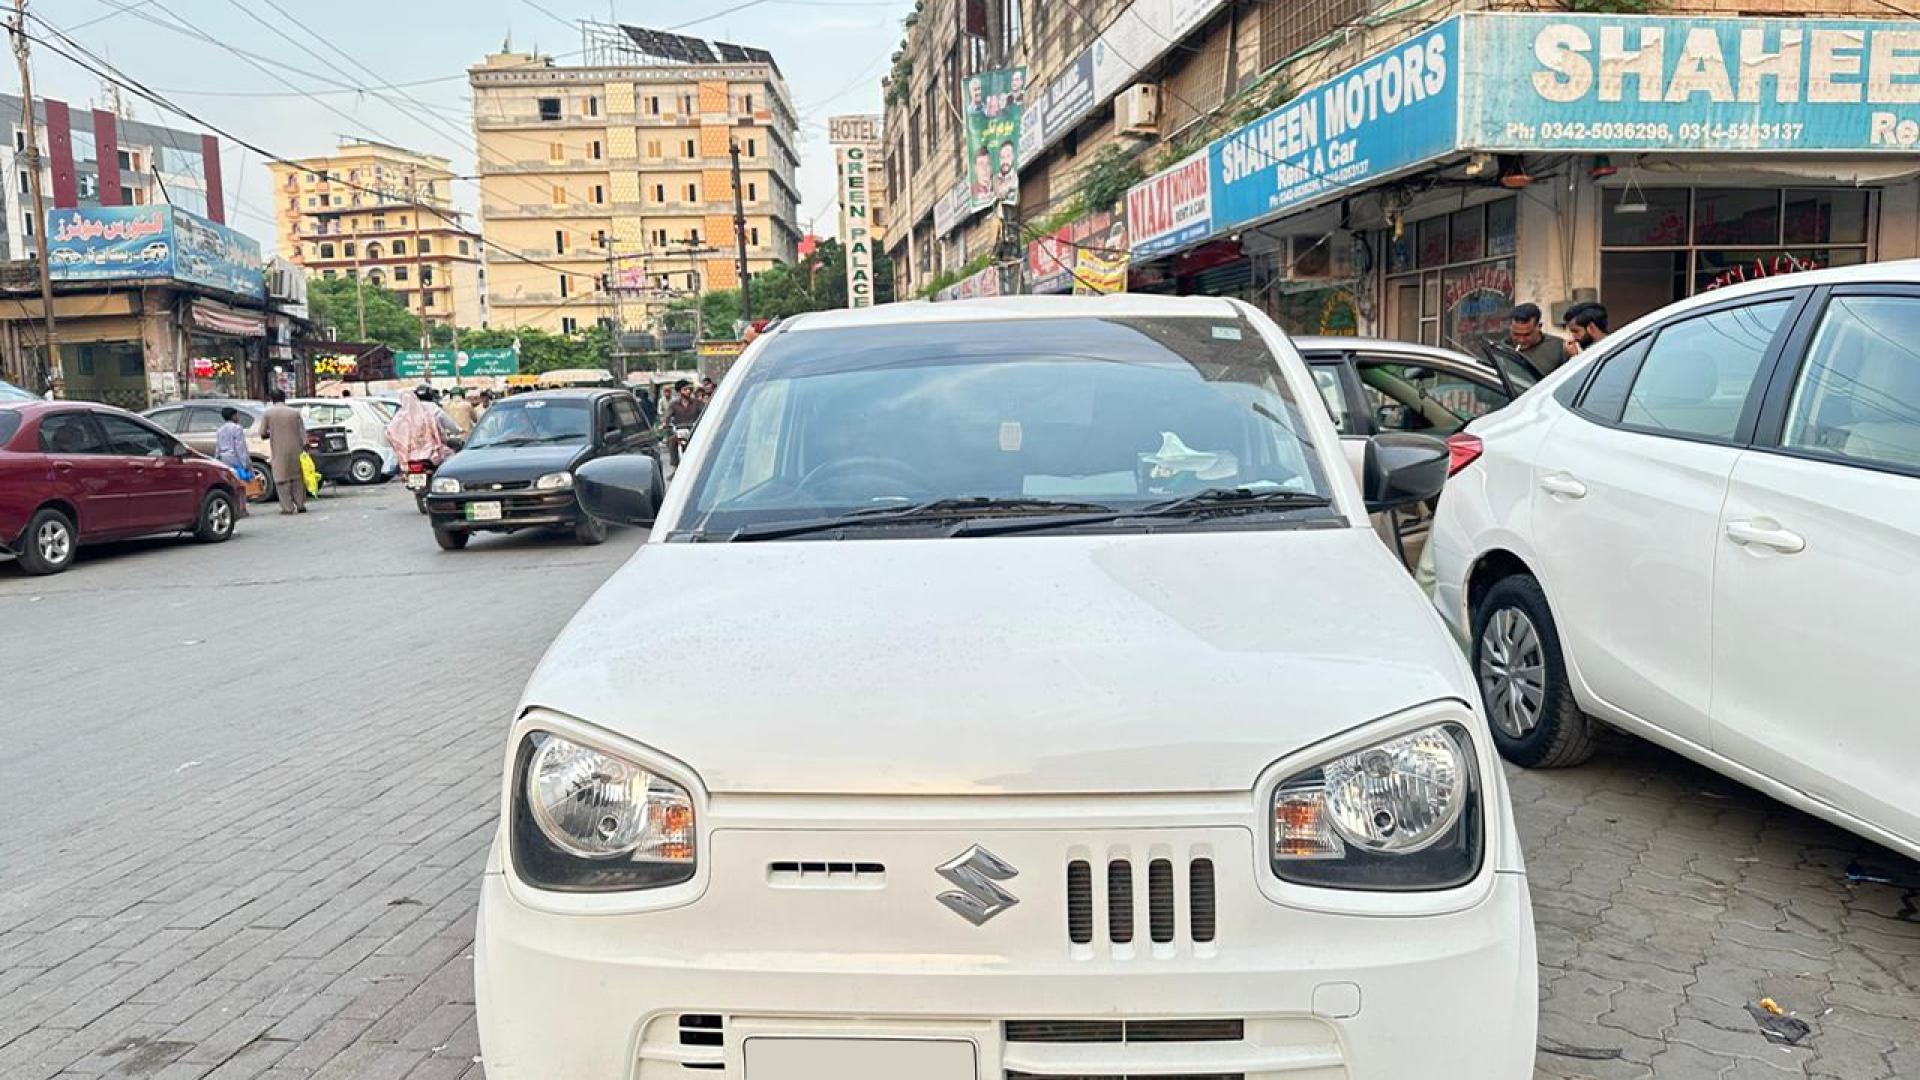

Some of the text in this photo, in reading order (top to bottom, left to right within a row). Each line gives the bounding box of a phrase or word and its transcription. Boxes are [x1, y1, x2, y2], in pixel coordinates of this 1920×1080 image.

[829, 119, 877, 140] HOTEL
[1222, 33, 1447, 184] SHAHEEN MOTORS
[1506, 123, 1535, 140] Ph:
[1277, 154, 1311, 190] Rent
[1314, 147, 1325, 174] A
[1328, 138, 1359, 170] Car
[848, 148, 870, 308] GREEN PALACE
[1130, 172, 1174, 242] NIAZI
